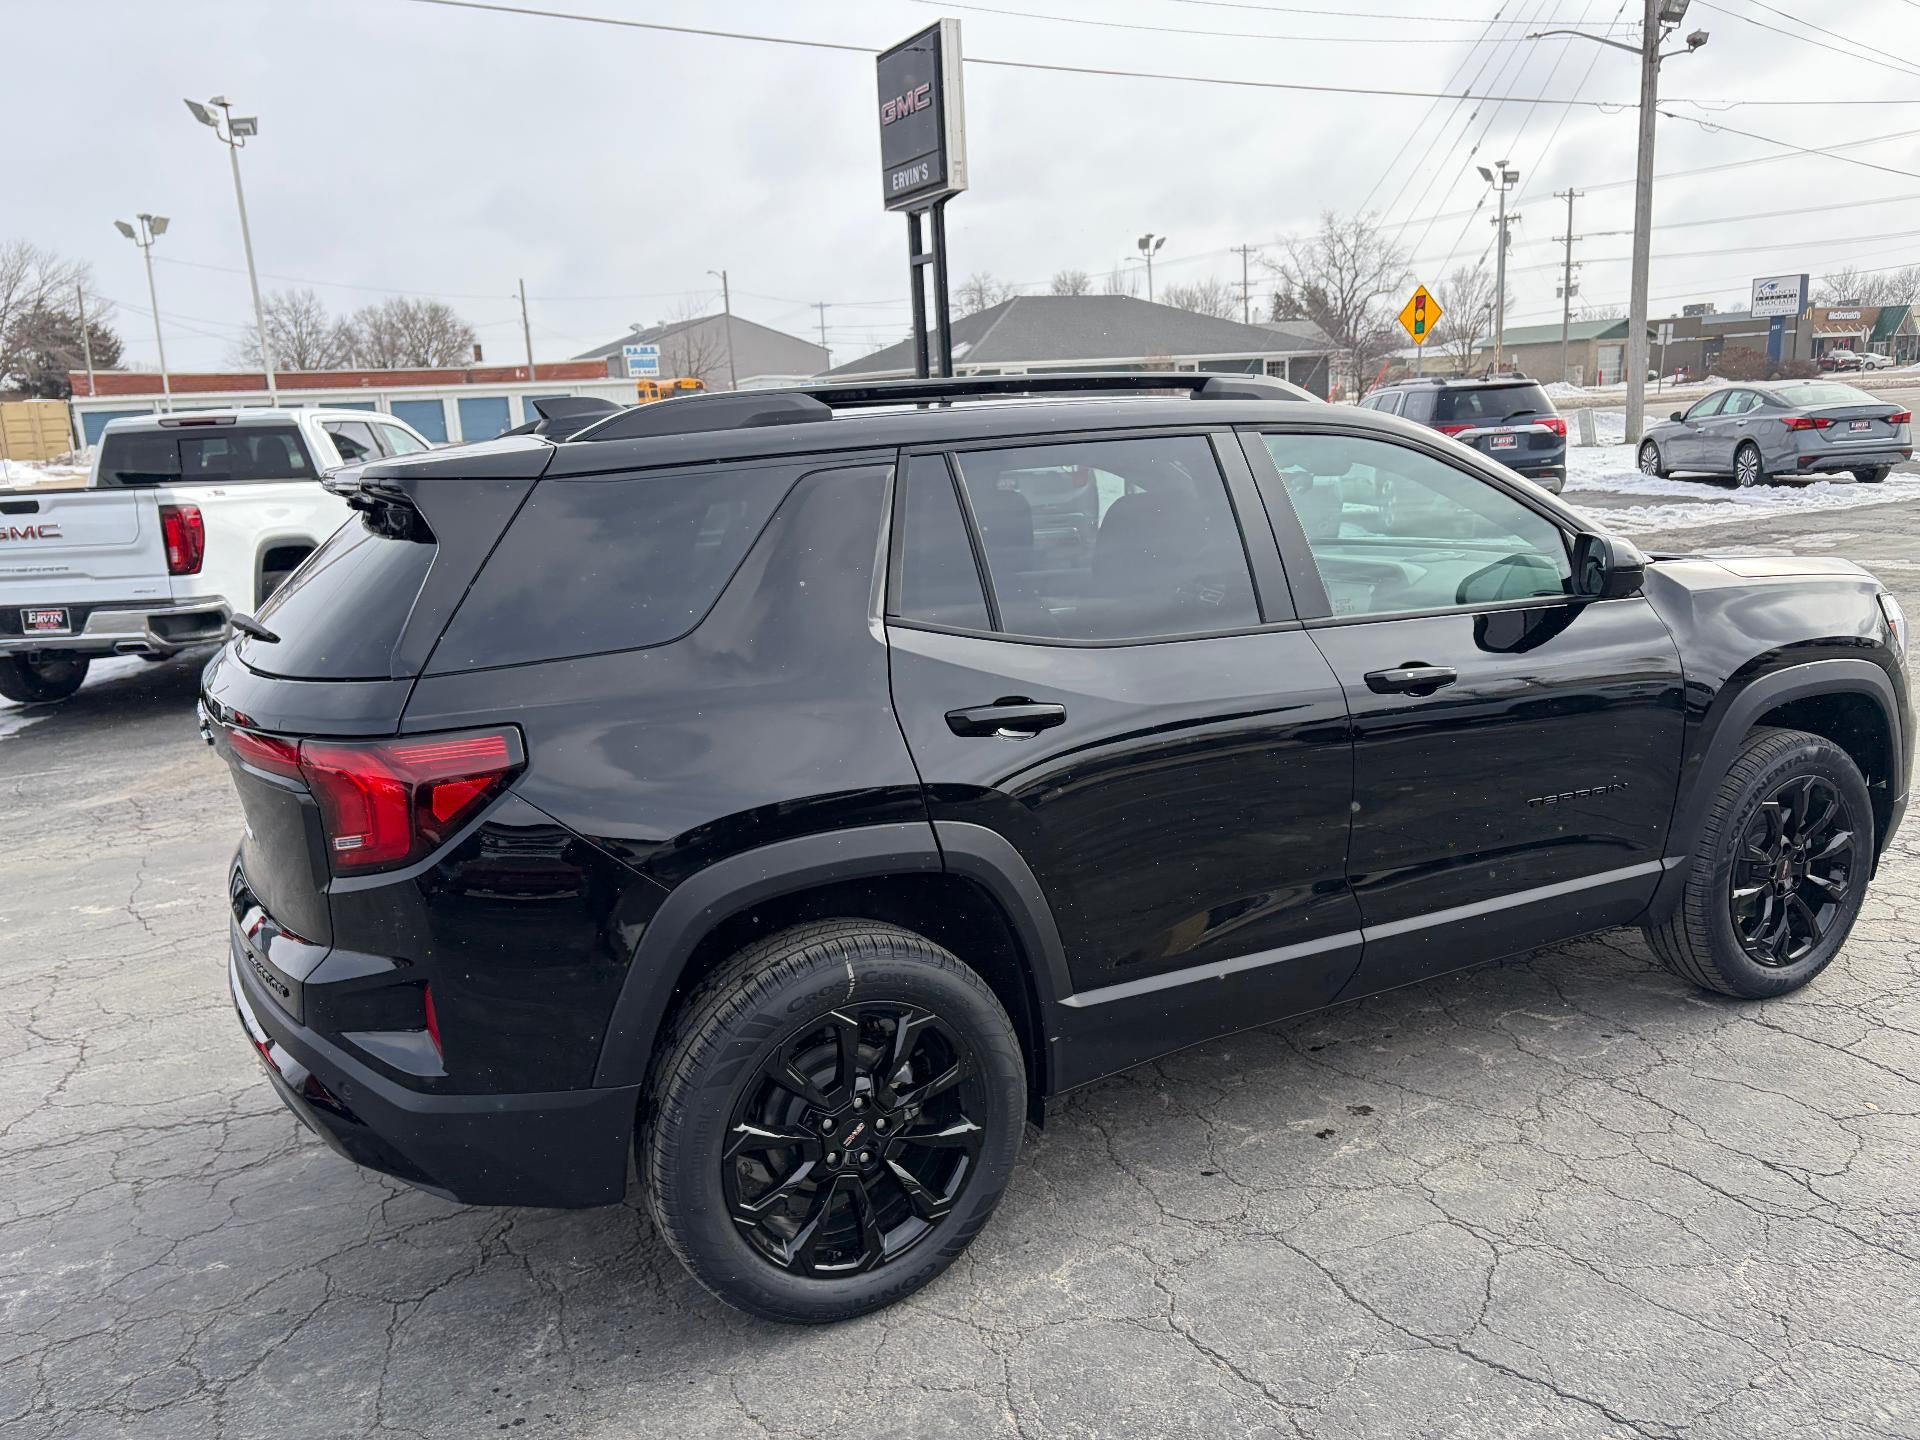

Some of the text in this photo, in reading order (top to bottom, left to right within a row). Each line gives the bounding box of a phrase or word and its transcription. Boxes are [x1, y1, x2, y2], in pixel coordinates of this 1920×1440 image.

[881, 82, 931, 126] GMC
[892, 163, 929, 191] ERVIN'S
[1828, 311, 1861, 320] McDonald's
[0, 524, 62, 542] MC
[28, 611, 64, 624] ERVIN
[1526, 781, 1629, 807] TERRAIN
